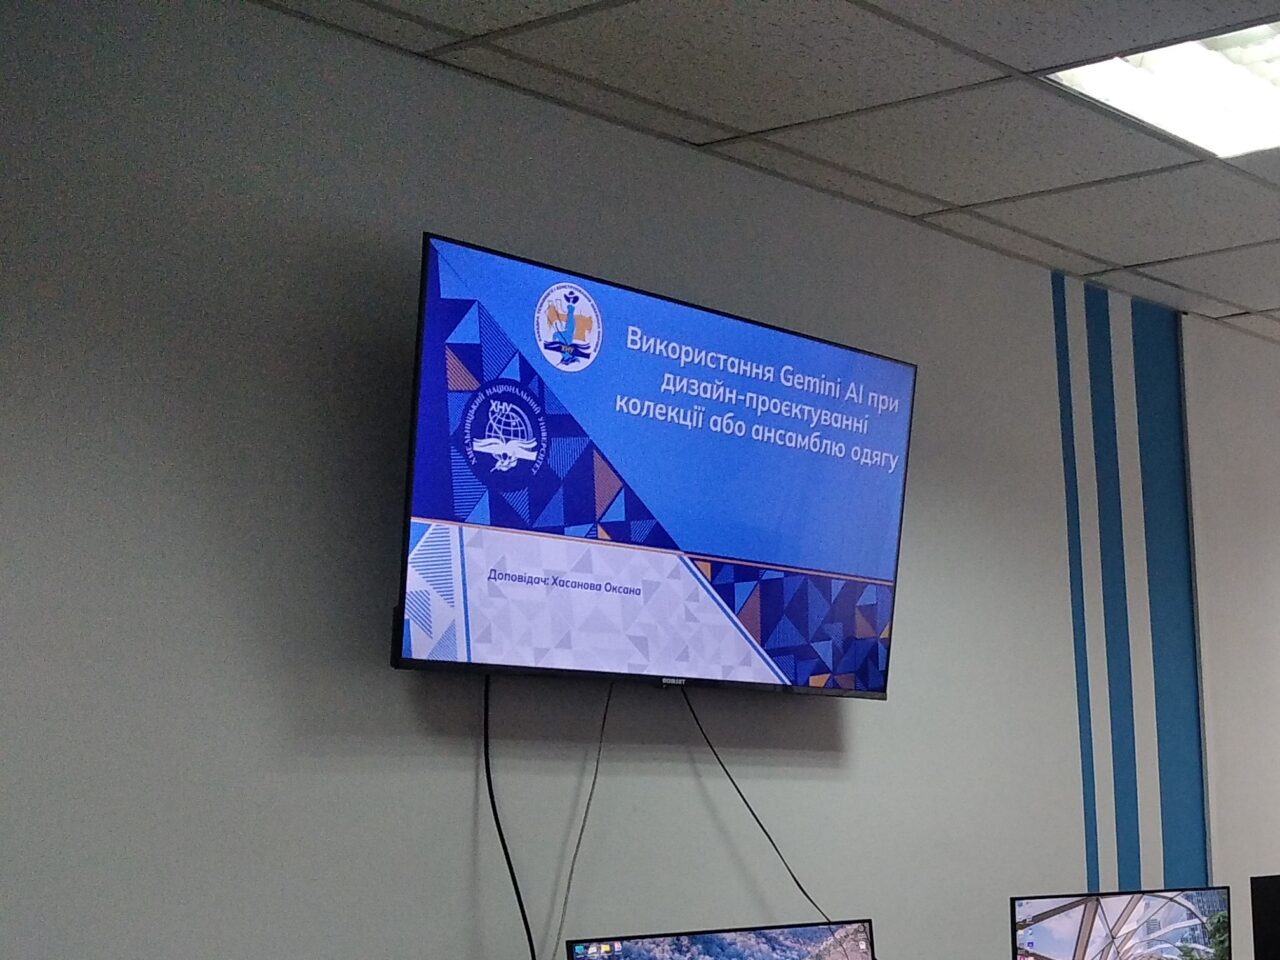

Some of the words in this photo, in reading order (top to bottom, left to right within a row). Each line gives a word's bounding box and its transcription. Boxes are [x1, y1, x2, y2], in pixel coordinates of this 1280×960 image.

[627, 326, 774, 382] Використання
[780, 365, 840, 399] Gemini
[845, 381, 863, 406] AI
[867, 391, 899, 415] при
[490, 399, 513, 413] ХНУ
[615, 394, 704, 430] колекції
[709, 413, 747, 437] або
[751, 424, 845, 458] ансамблю
[851, 445, 899, 474] одягу
[661, 372, 868, 434] дизайн-проєктуванні
[487, 568, 550, 586] Доповідач:
[551, 575, 602, 591] Хасанова
[604, 582, 641, 596] Оксана
